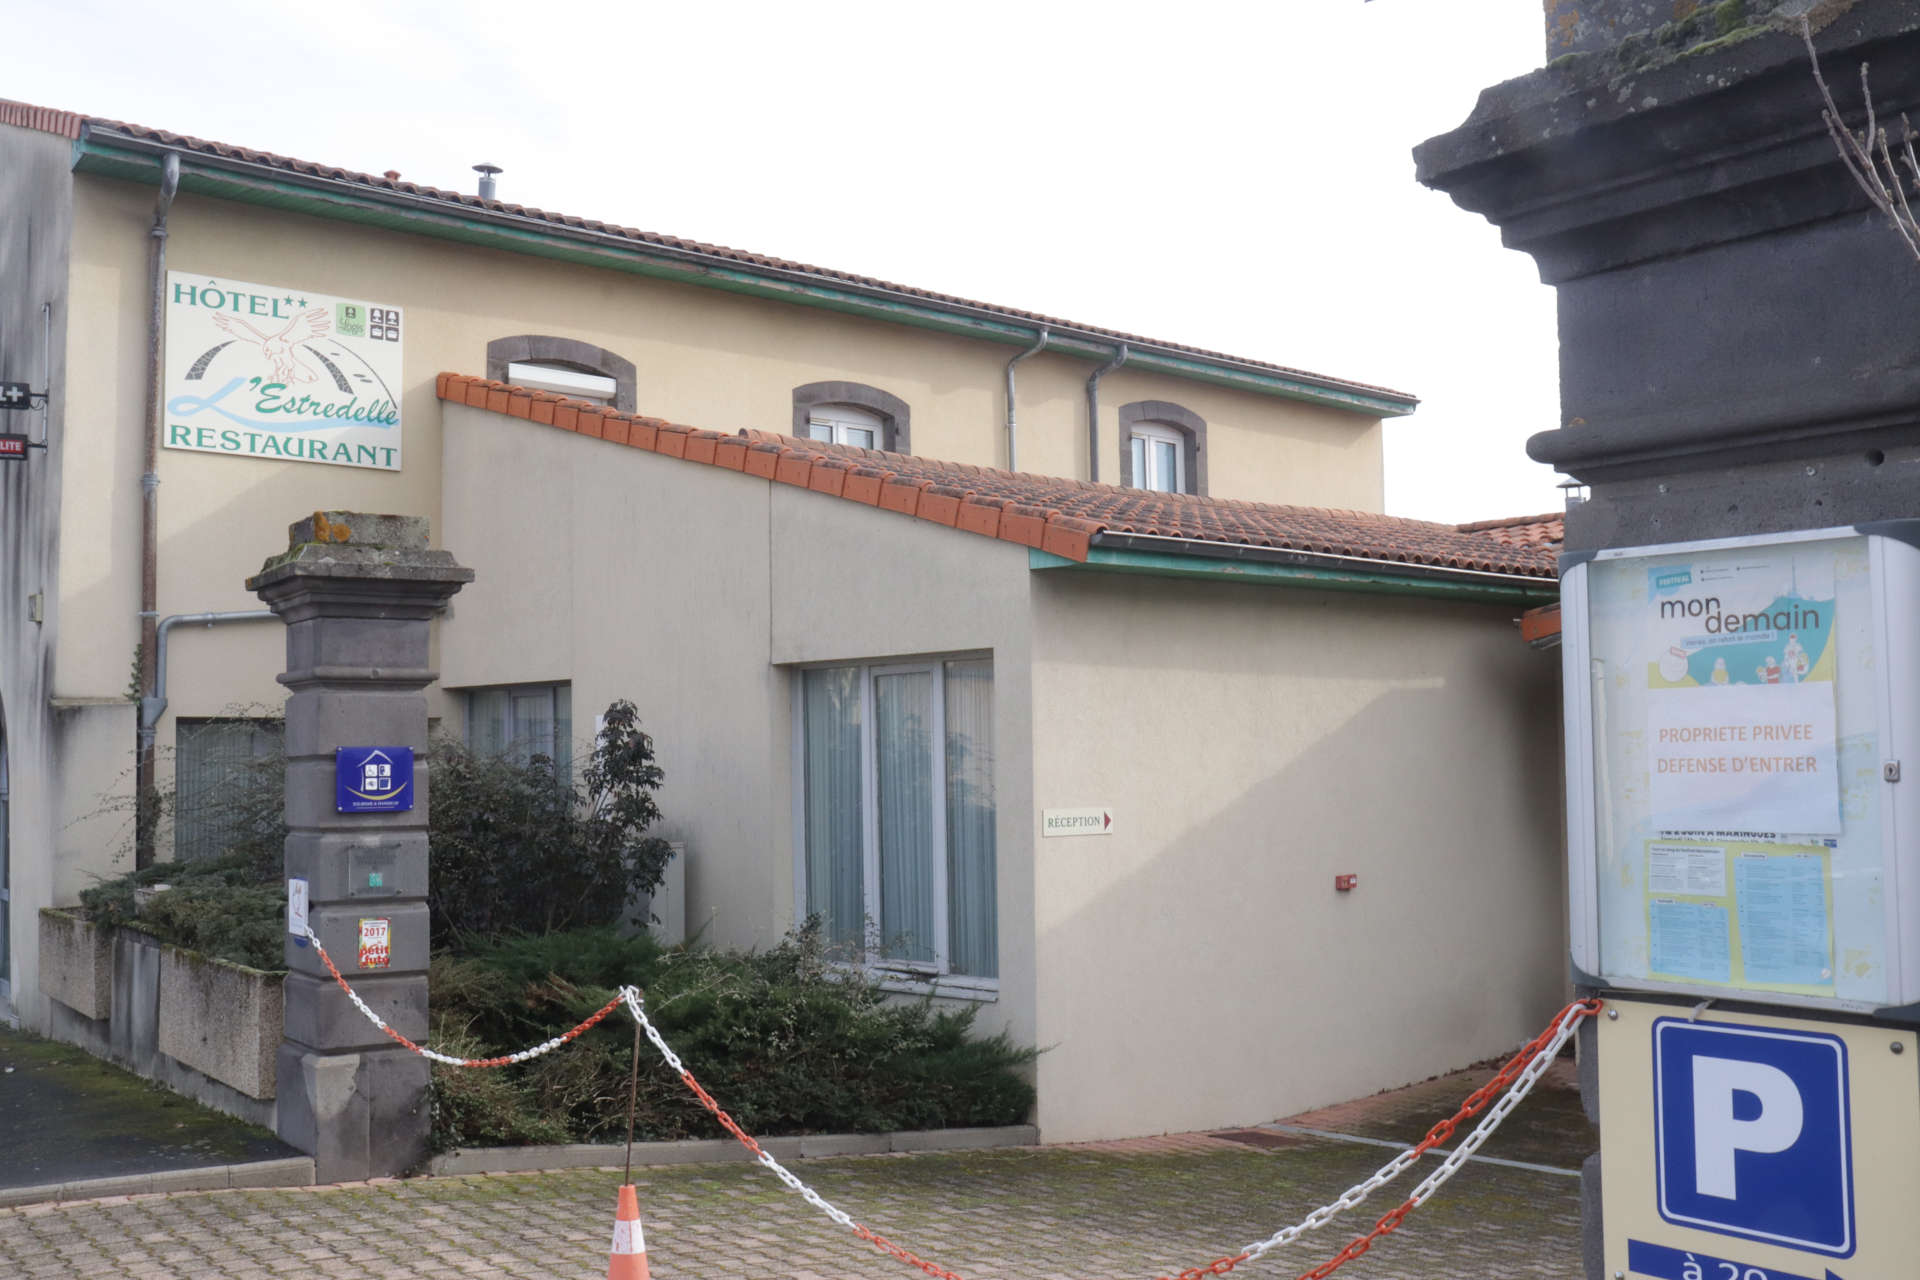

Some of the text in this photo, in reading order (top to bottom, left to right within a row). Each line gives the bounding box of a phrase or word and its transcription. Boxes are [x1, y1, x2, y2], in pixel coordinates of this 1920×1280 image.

[174, 280, 289, 319] HÔTEL
[170, 425, 398, 467] RESTAURANT
[1660, 597, 1720, 618] mon
[1705, 604, 1820, 634] demain
[1659, 724, 1814, 742] PROPRIETE PRIVEE
[1656, 756, 1818, 773] DEFENSE D'ENTRER
[364, 927, 386, 937] 2017
[1692, 1054, 1804, 1201] P
